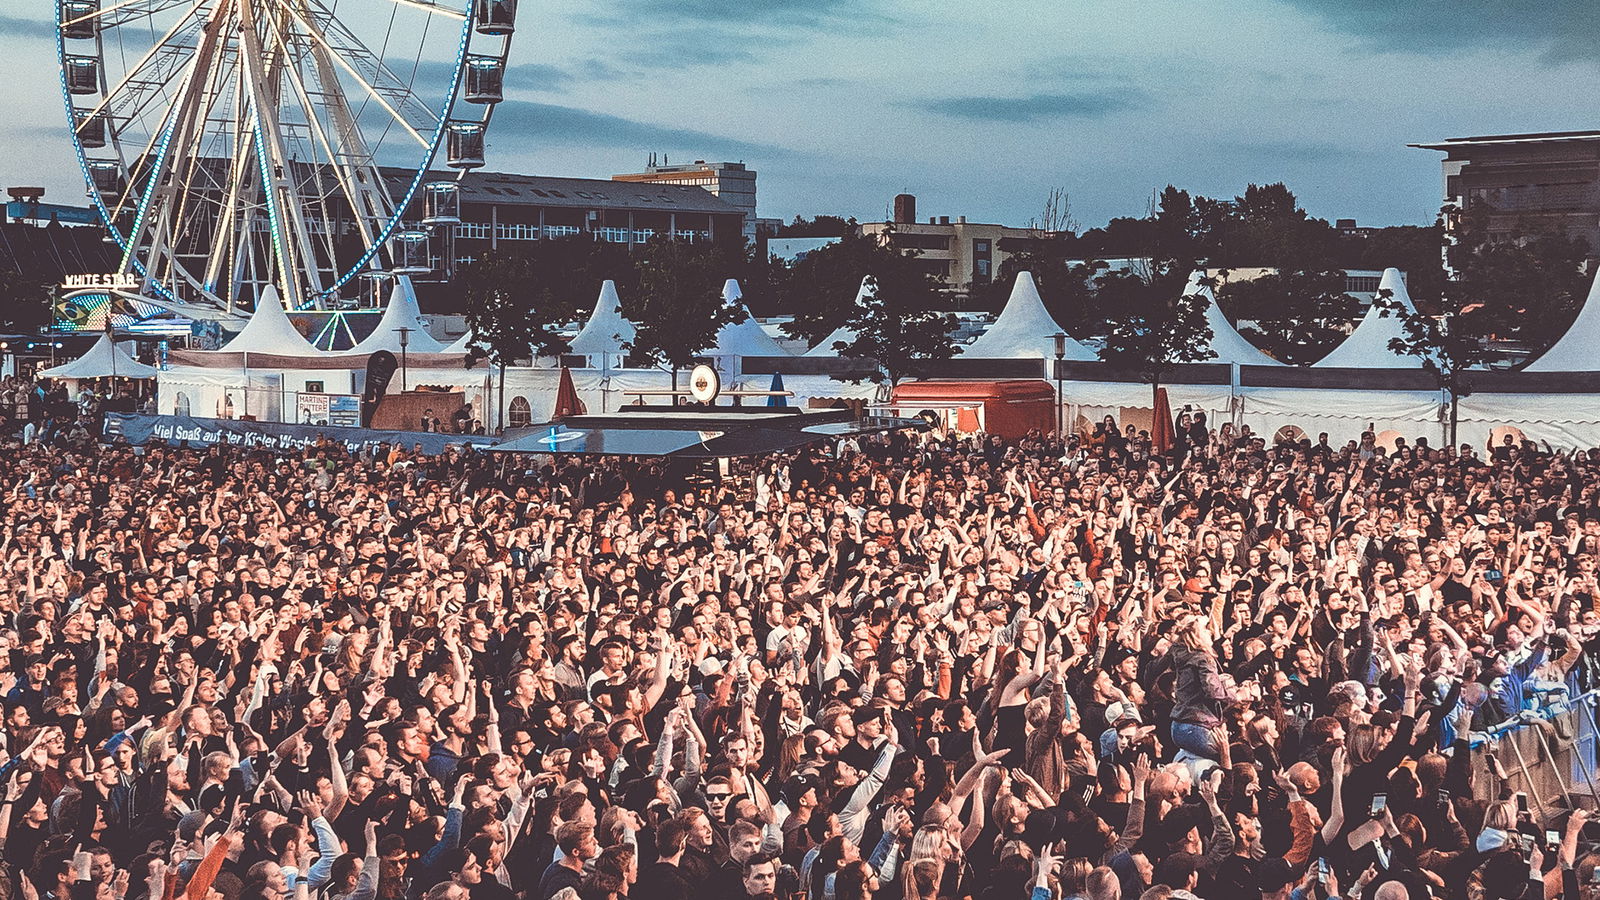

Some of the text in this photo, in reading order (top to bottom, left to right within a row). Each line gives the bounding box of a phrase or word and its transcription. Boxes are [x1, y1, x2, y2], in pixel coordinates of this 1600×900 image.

[65, 273, 135, 286] WHITE STAR
[154, 424, 173, 440] Viel
[203, 429, 222, 443] auf
